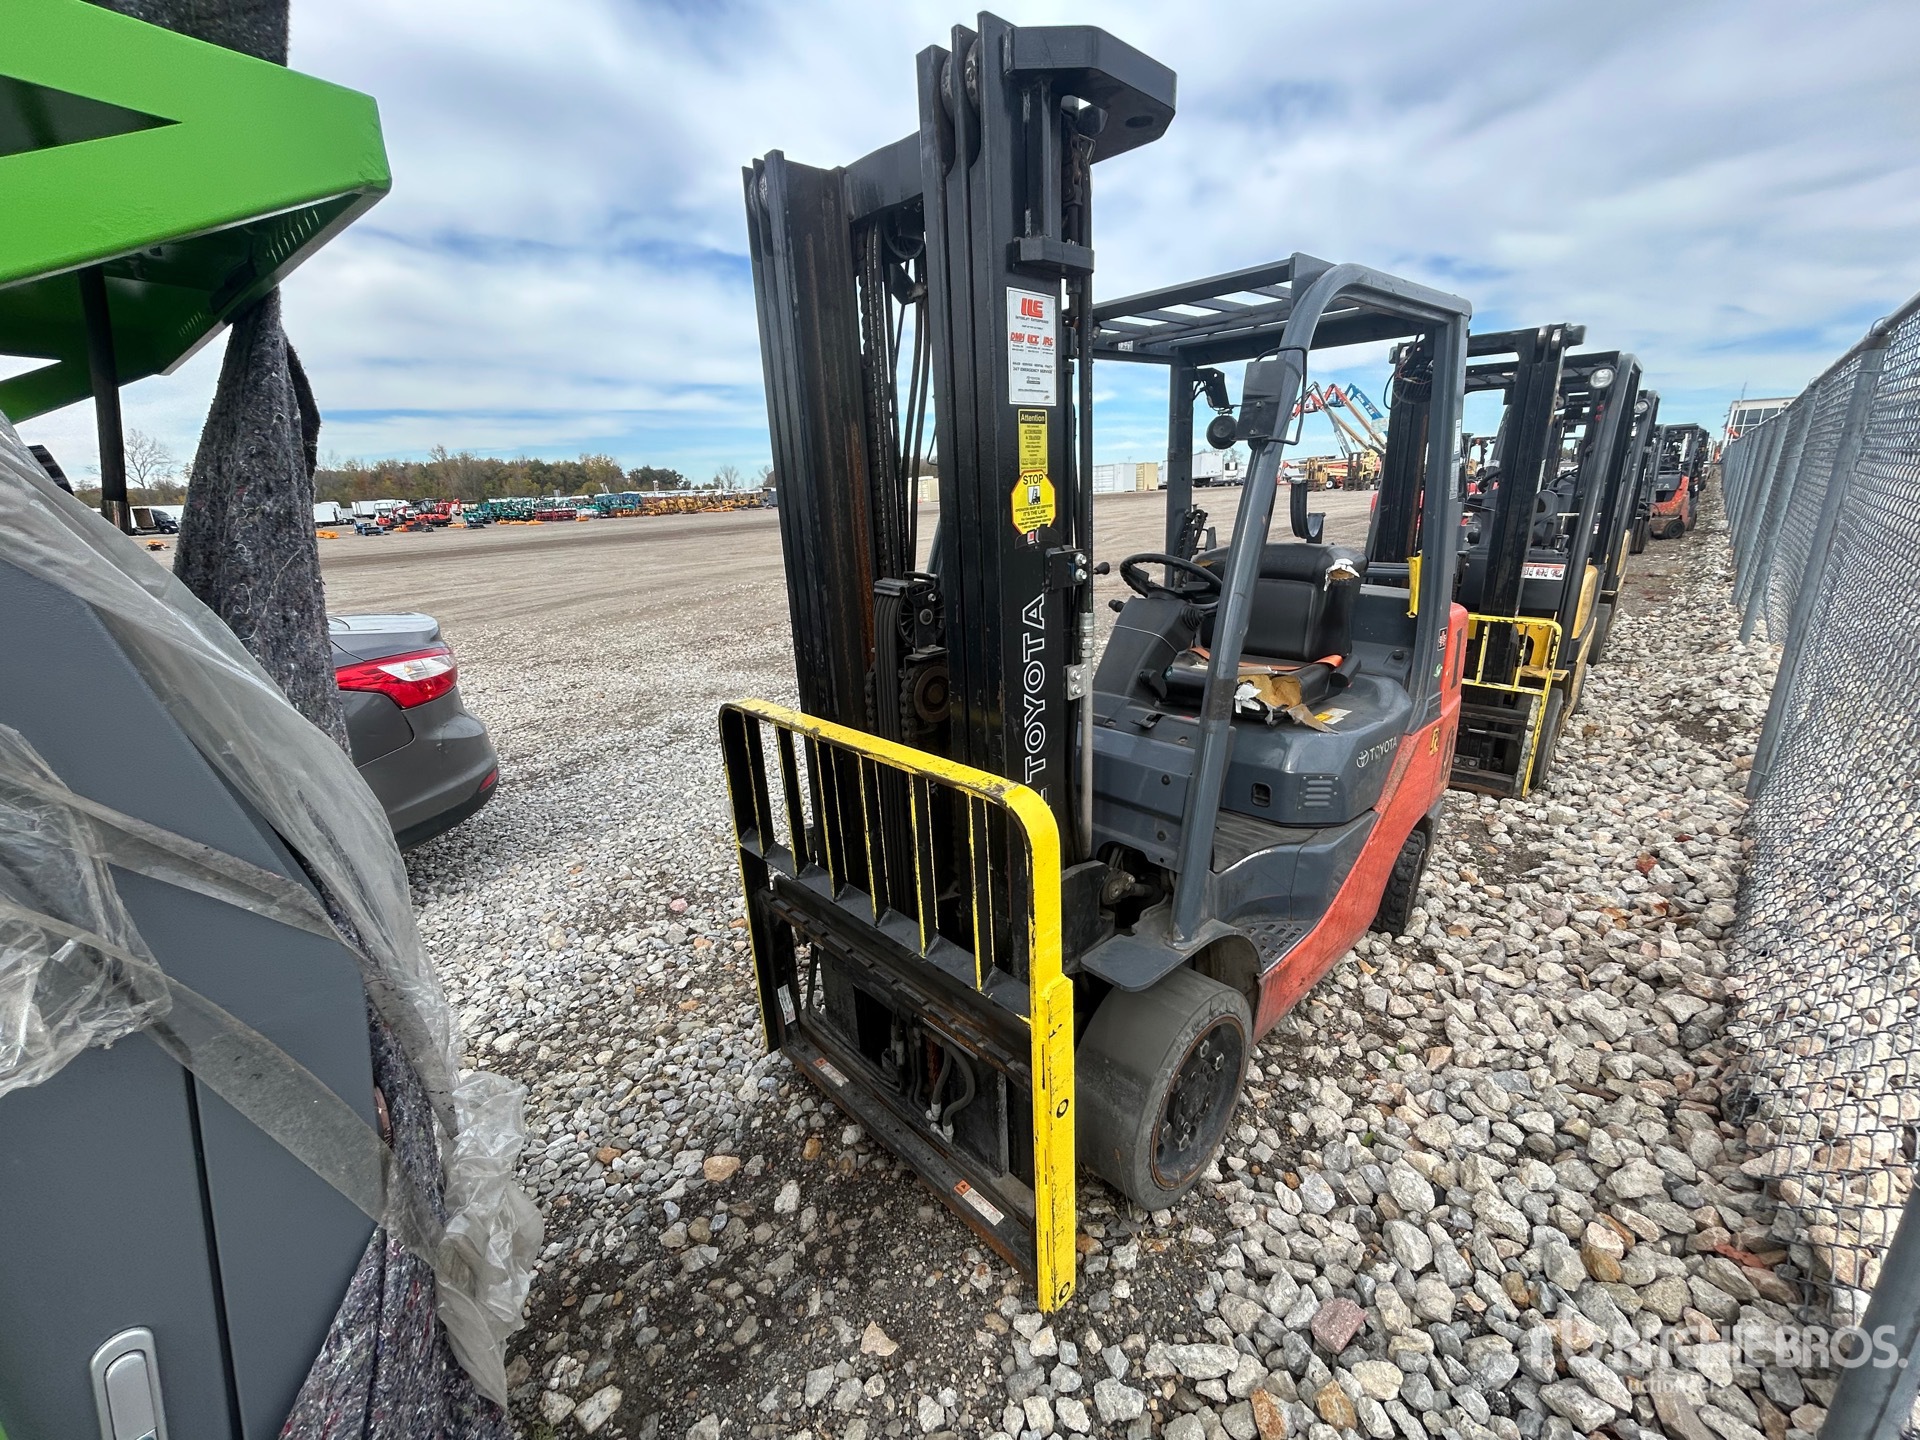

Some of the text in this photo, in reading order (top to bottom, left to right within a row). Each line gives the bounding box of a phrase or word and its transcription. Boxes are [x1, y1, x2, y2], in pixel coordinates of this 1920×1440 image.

[1021, 414, 1045, 422] Attention
[1023, 474, 1043, 485] STOP
[1022, 593, 1046, 784] TOYOTA
[1369, 736, 1398, 761] TOYOTA
